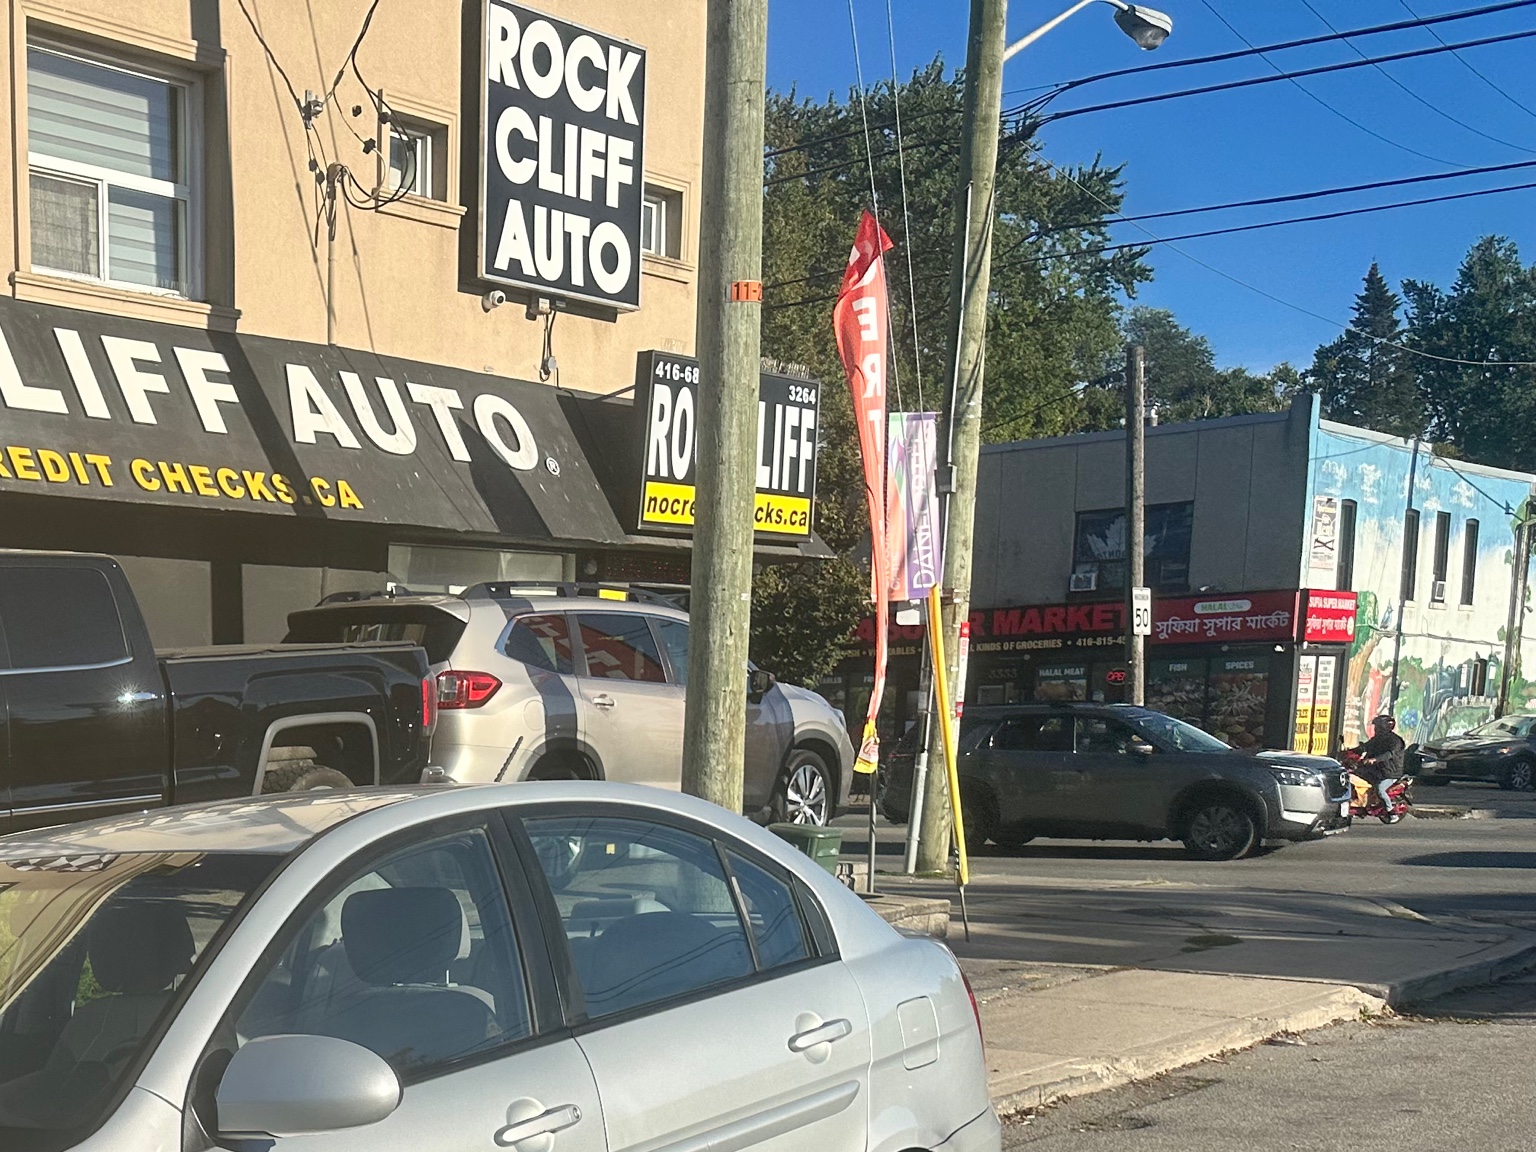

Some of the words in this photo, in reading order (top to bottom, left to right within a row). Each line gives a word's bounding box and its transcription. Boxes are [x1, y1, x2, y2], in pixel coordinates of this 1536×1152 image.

[489, 3, 641, 126] ROCK
[495, 106, 634, 209] CLIFF
[494, 198, 632, 294] AUTO
[788, 385, 816, 404] 3264
[286, 362, 539, 472] AUTO
[1135, 608, 1149, 628] 50
[1156, 616, 1200, 639] সুফিয়া
[1203, 616, 1243, 637] সুপার
[1246, 610, 1290, 630] মার্কেট
[976, 641, 1001, 652] KINDS
[1002, 640, 1015, 651] OF
[1015, 638, 1062, 650] GROCERIES
[1039, 668, 1063, 677] HALAL
[1064, 667, 1085, 676] MEAT
[1168, 663, 1188, 672] FISH
[1225, 660, 1255, 670] SPICES
[1106, 671, 1126, 682] OPE
